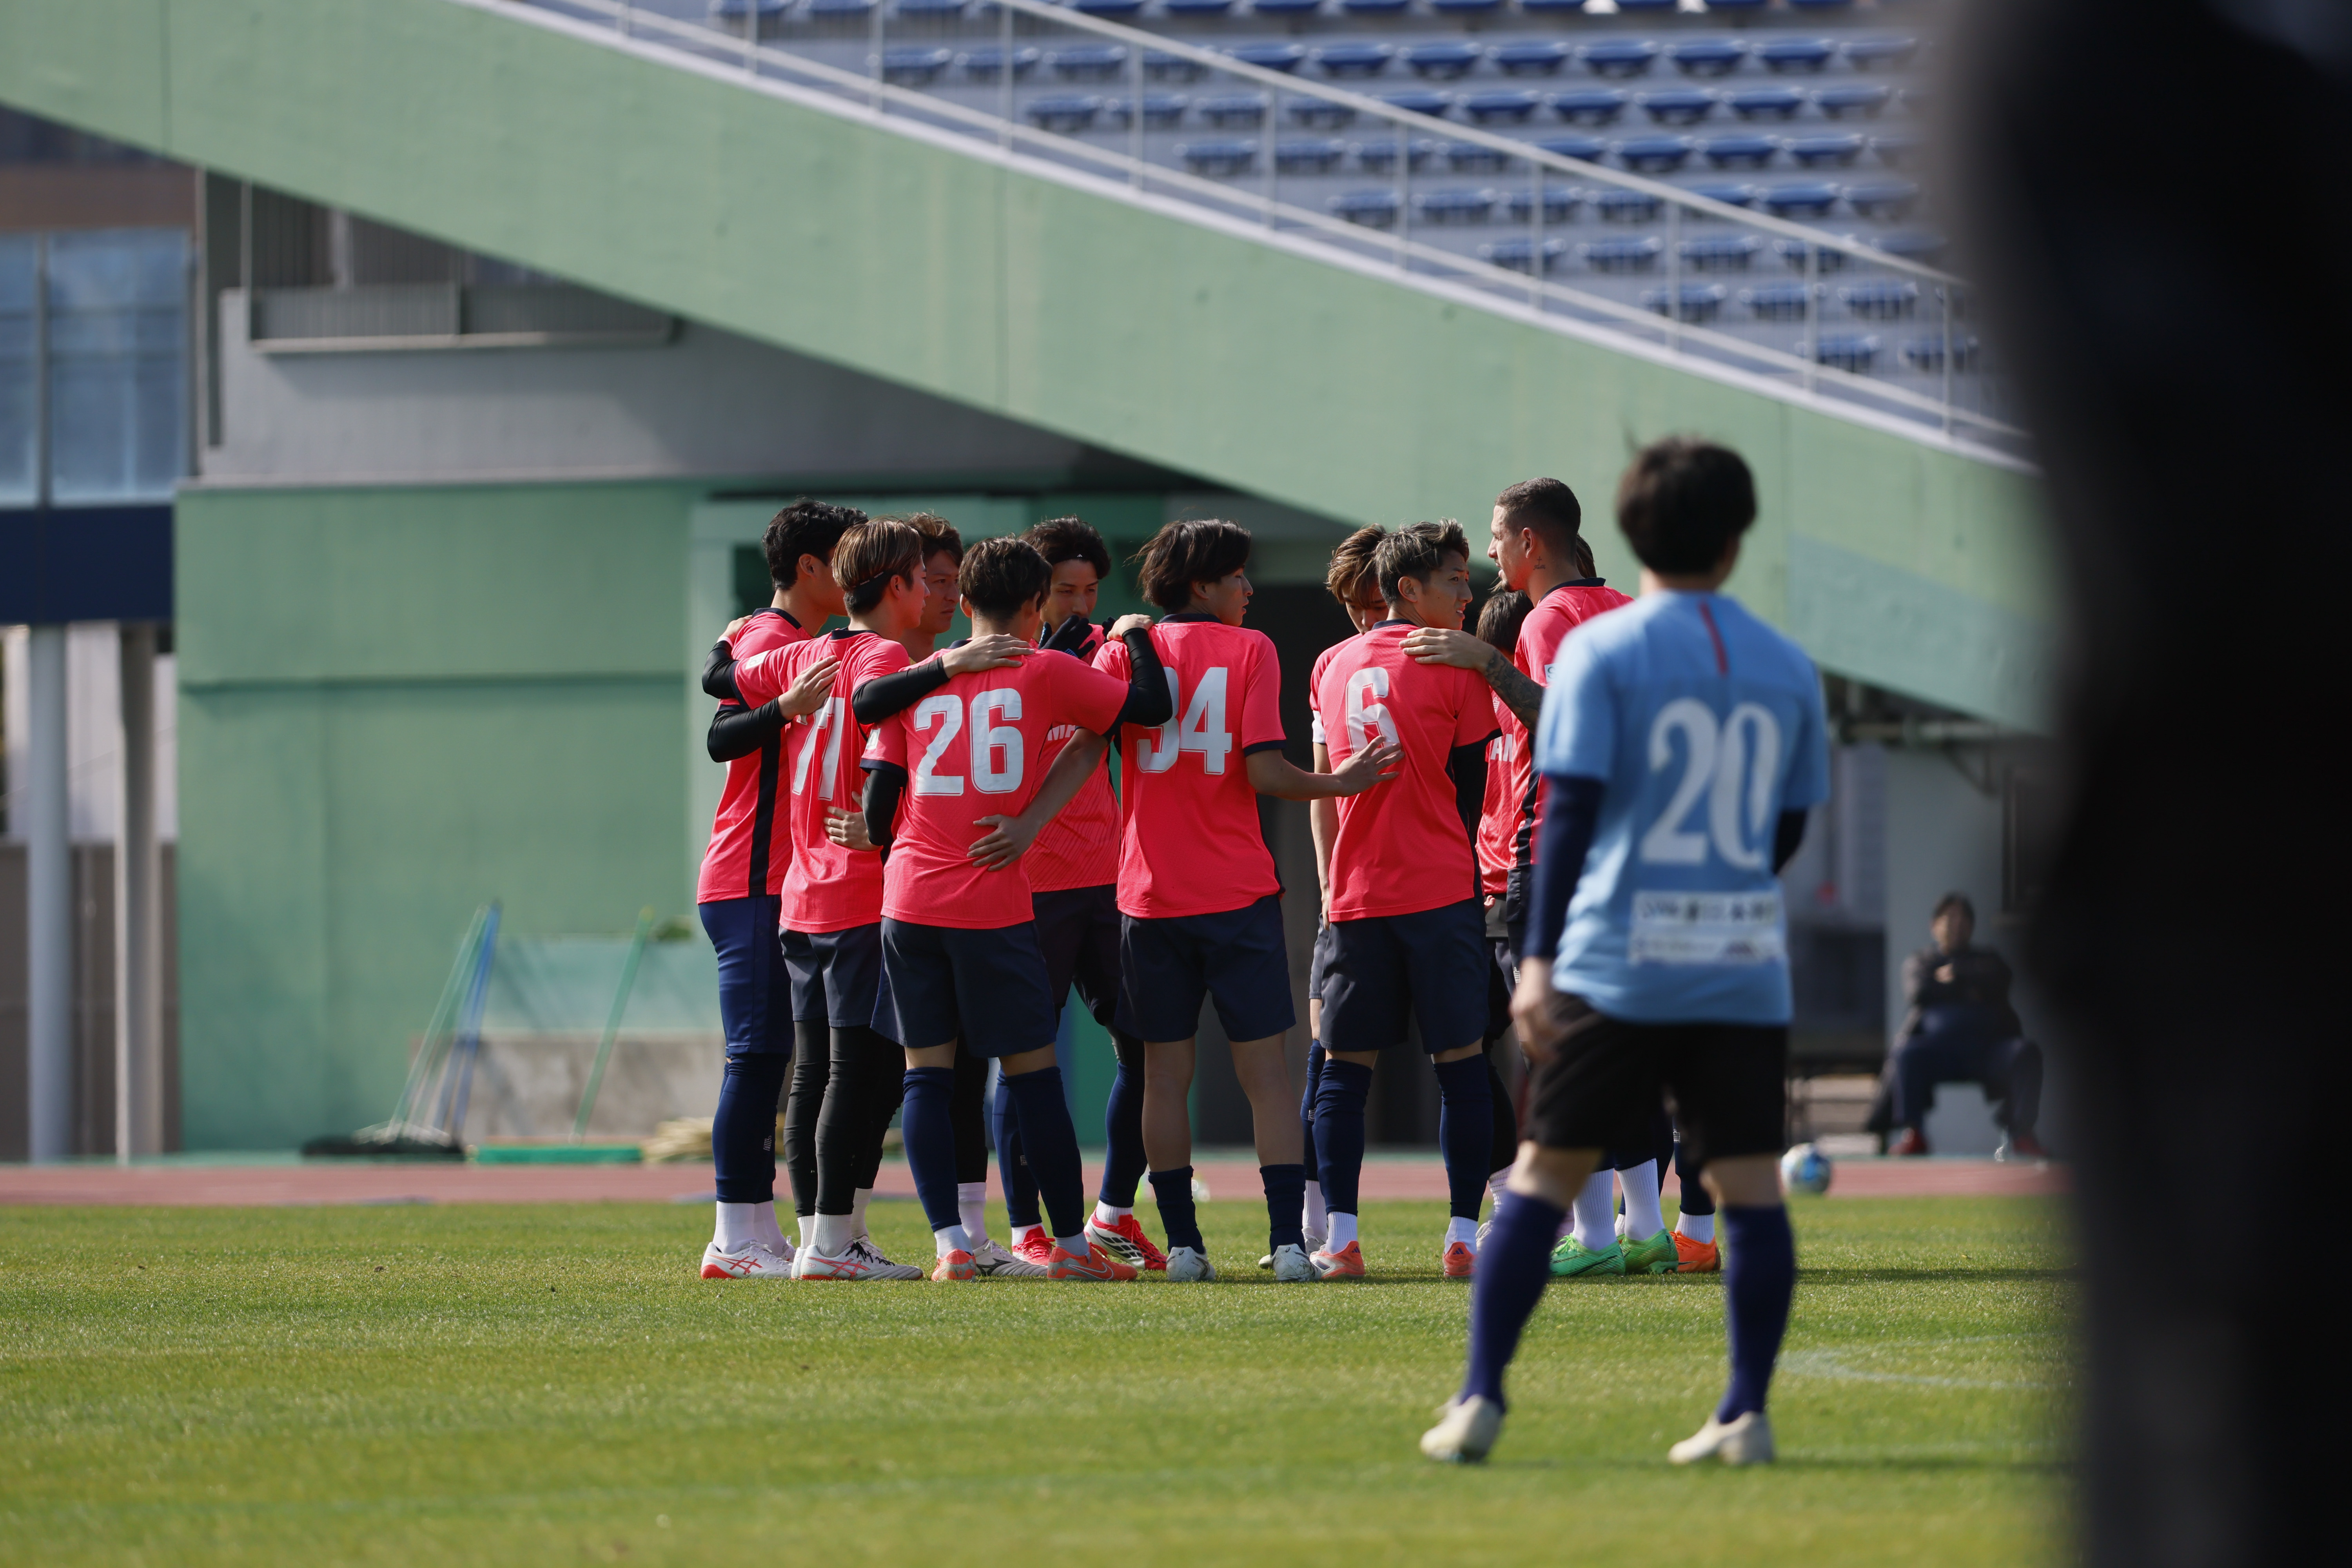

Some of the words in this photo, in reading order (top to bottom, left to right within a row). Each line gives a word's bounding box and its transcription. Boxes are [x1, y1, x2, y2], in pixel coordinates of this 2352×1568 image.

[914, 688, 1024, 796] 26
[1345, 667, 1401, 764] 6
[1640, 697, 1782, 870] 20
